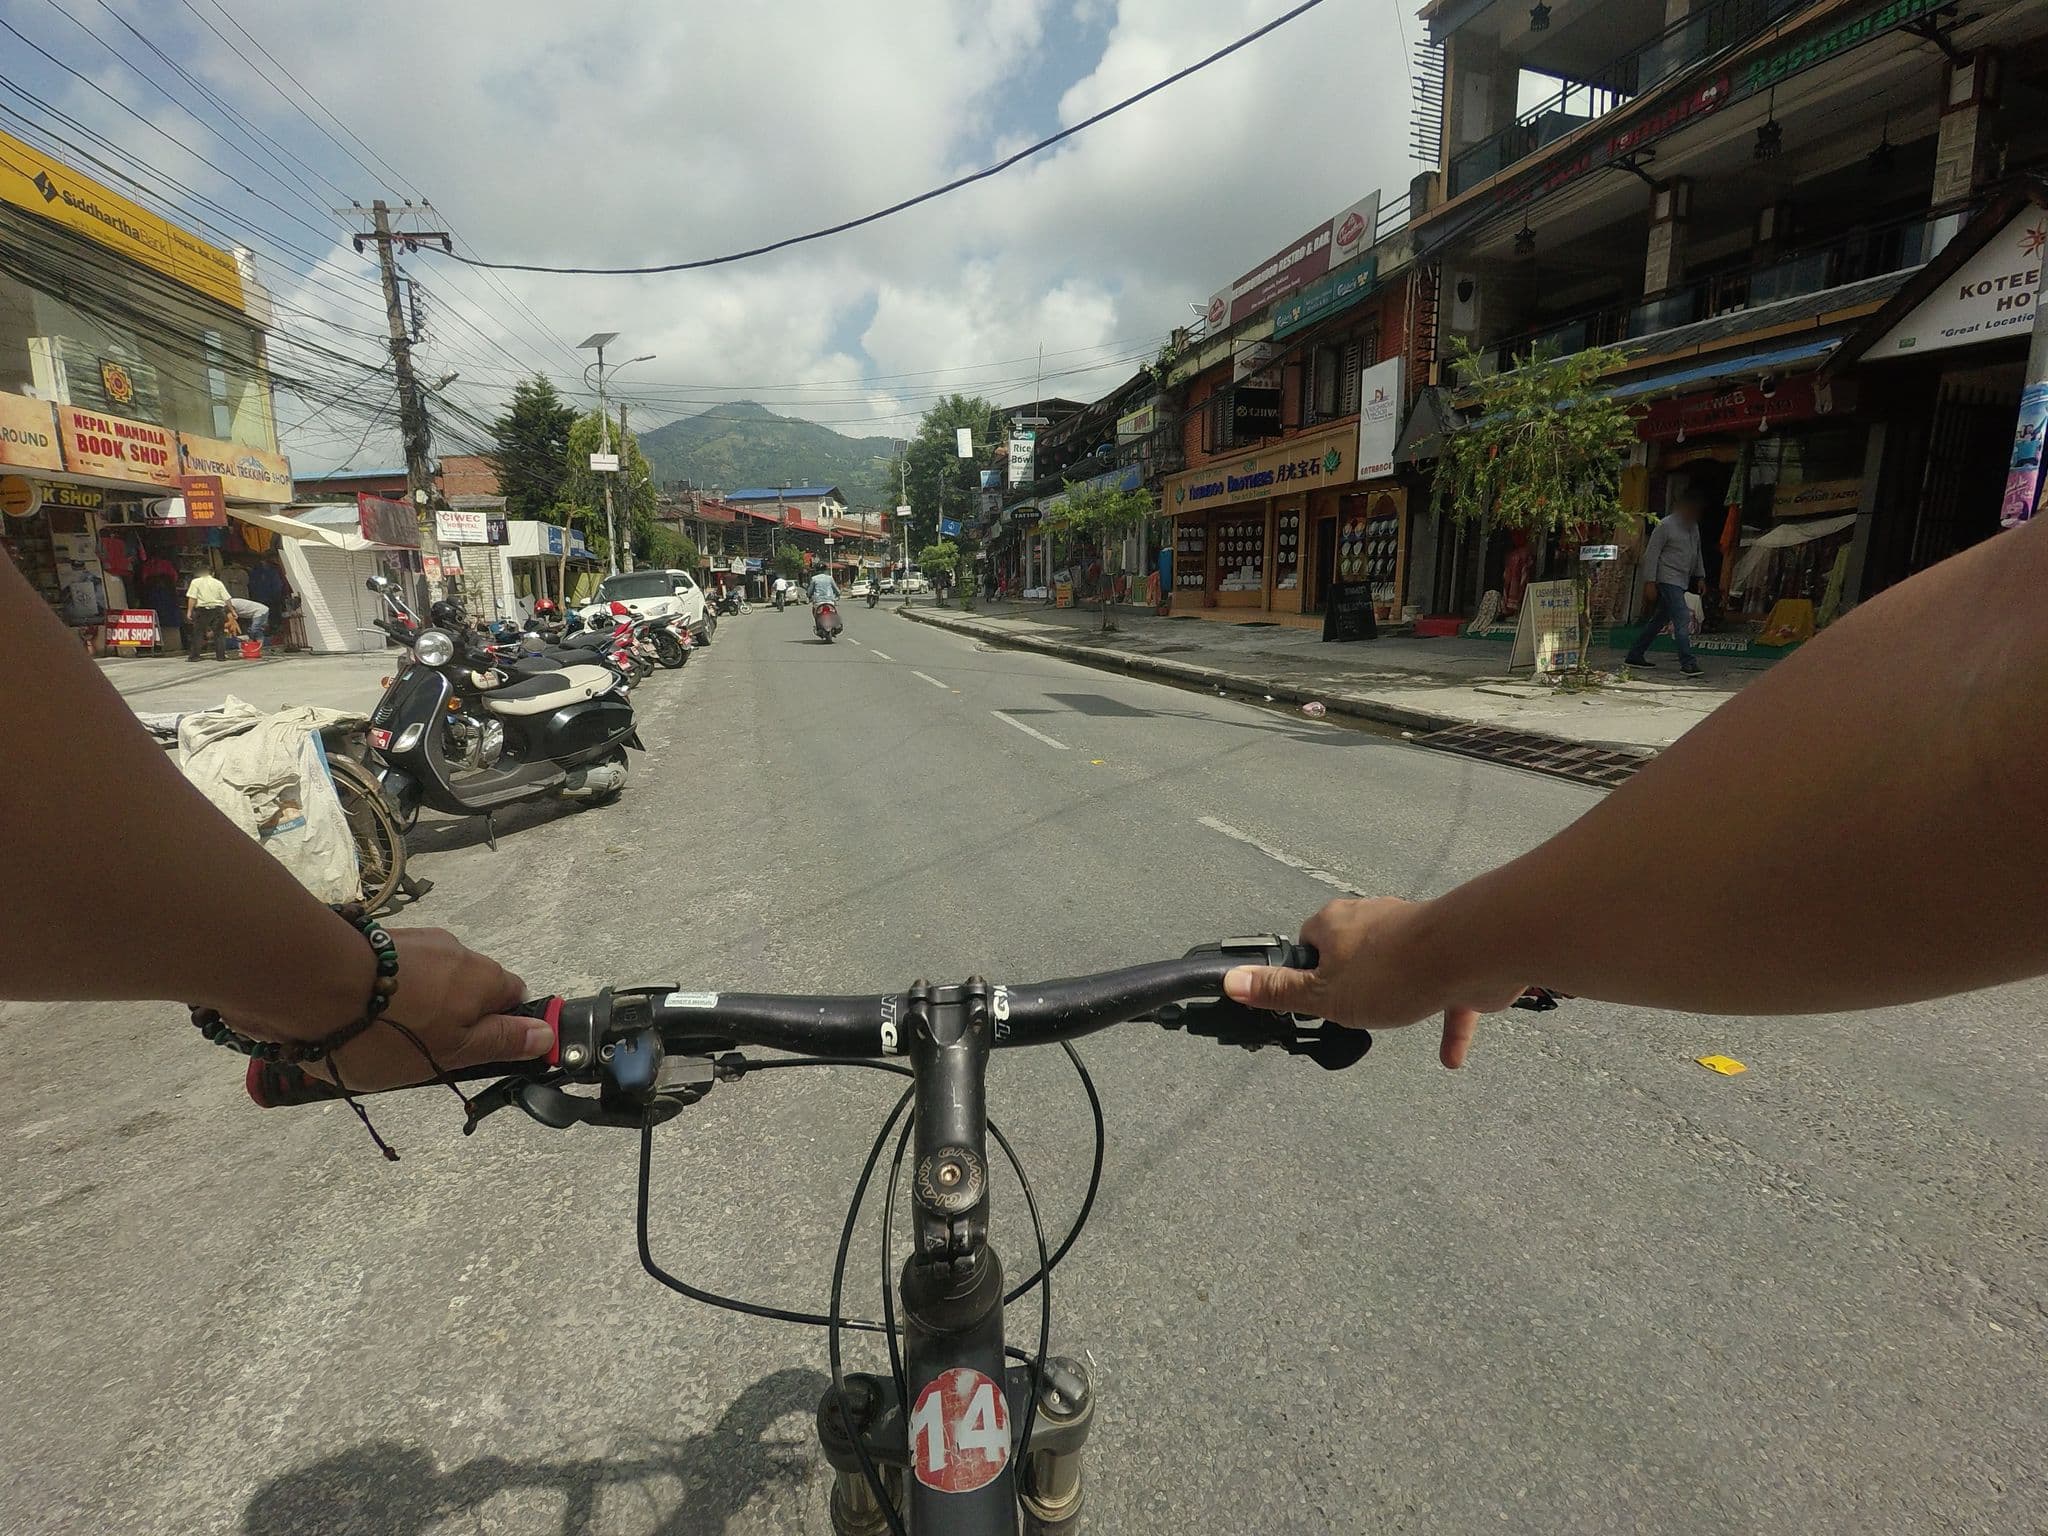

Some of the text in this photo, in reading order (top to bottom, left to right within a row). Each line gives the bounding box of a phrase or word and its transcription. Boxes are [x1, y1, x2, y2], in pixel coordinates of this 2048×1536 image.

[1313, 230, 1331, 252] BAR
[1960, 269, 2039, 300] KOTEE
[1985, 313, 2035, 330] Locatio
[0, 427, 48, 447] ROUND
[73, 413, 166, 446] NEPAL MANDALA
[76, 433, 168, 466] BOOK SHOP
[1013, 444, 1031, 452] Rice
[1011, 455, 1033, 463] Bowl
[237, 464, 271, 482] TREKKING
[272, 472, 289, 485] SHOP
[60, 490, 101, 507] SHOP
[191, 501, 214, 510] BOOK
[193, 511, 215, 520] SHOP
[443, 512, 480, 522] CIWEC
[107, 627, 153, 641] BOOK SHOP
[912, 1383, 1010, 1472] 14
